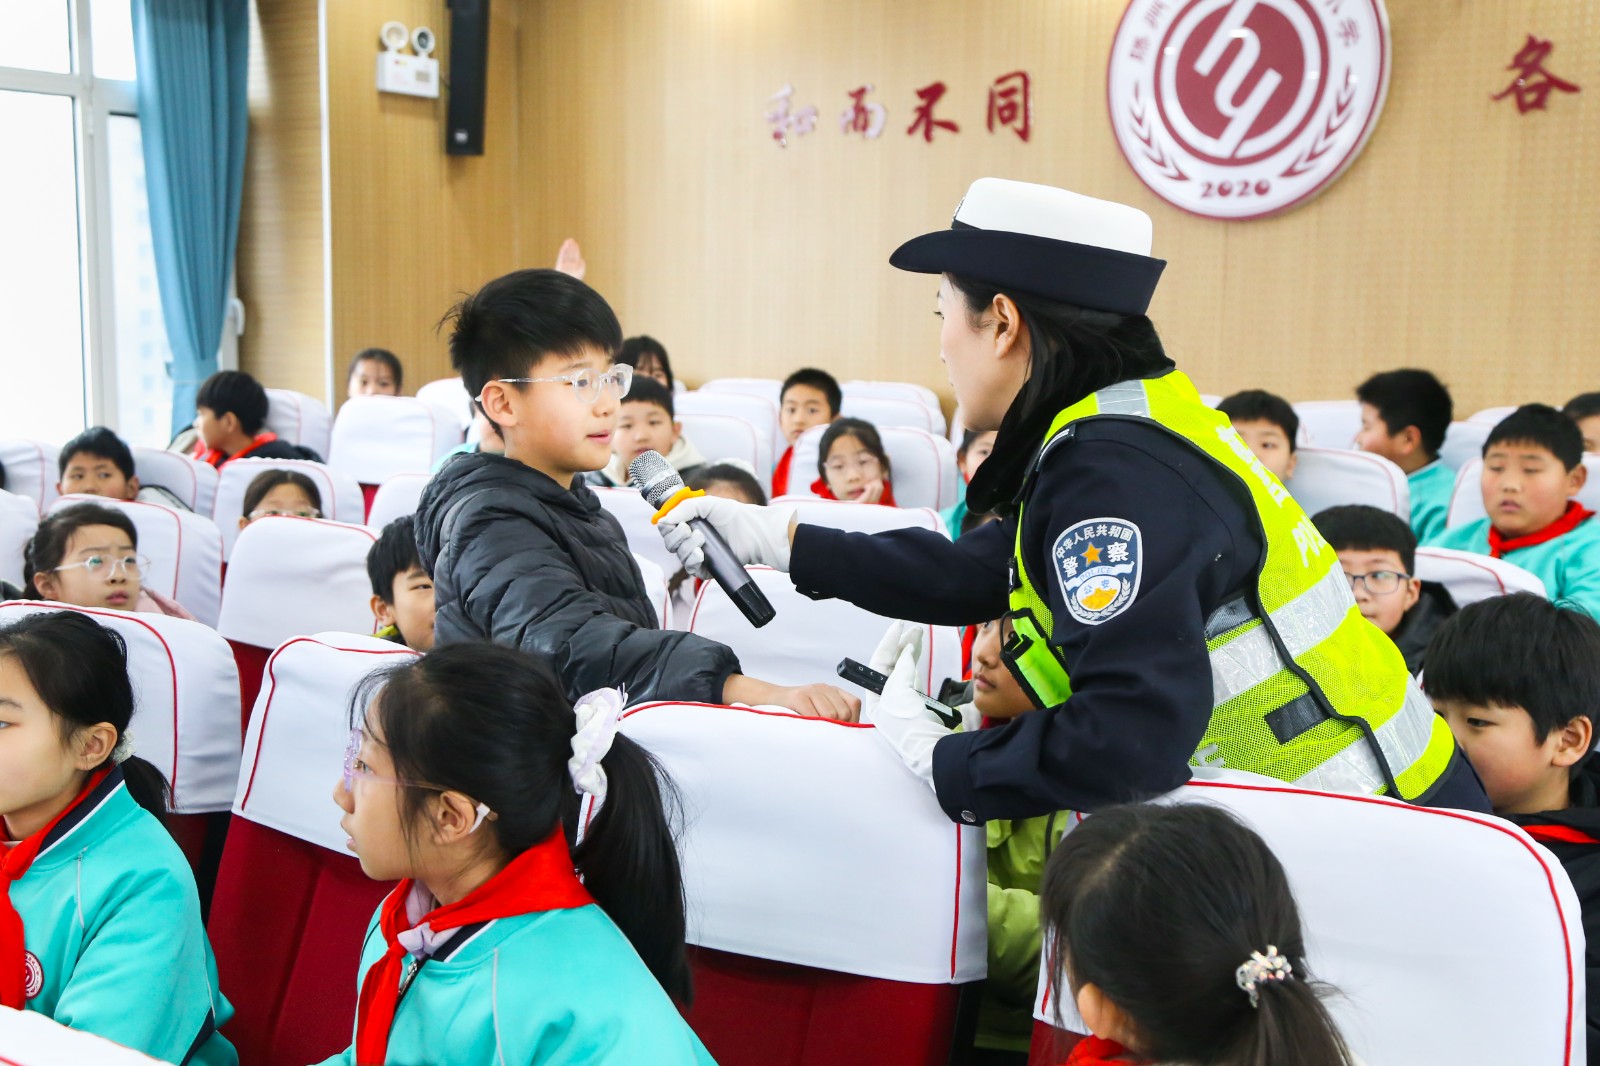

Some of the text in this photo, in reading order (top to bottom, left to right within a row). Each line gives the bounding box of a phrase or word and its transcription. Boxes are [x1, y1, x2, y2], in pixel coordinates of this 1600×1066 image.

[1489, 33, 1581, 115] 各
[765, 70, 1031, 148] 和而不同
[1201, 178, 1270, 198] 2020
[1056, 524, 1134, 559] 中华人民共和国
[1062, 541, 1129, 578] 警察
[1079, 566, 1113, 582] POLICE
